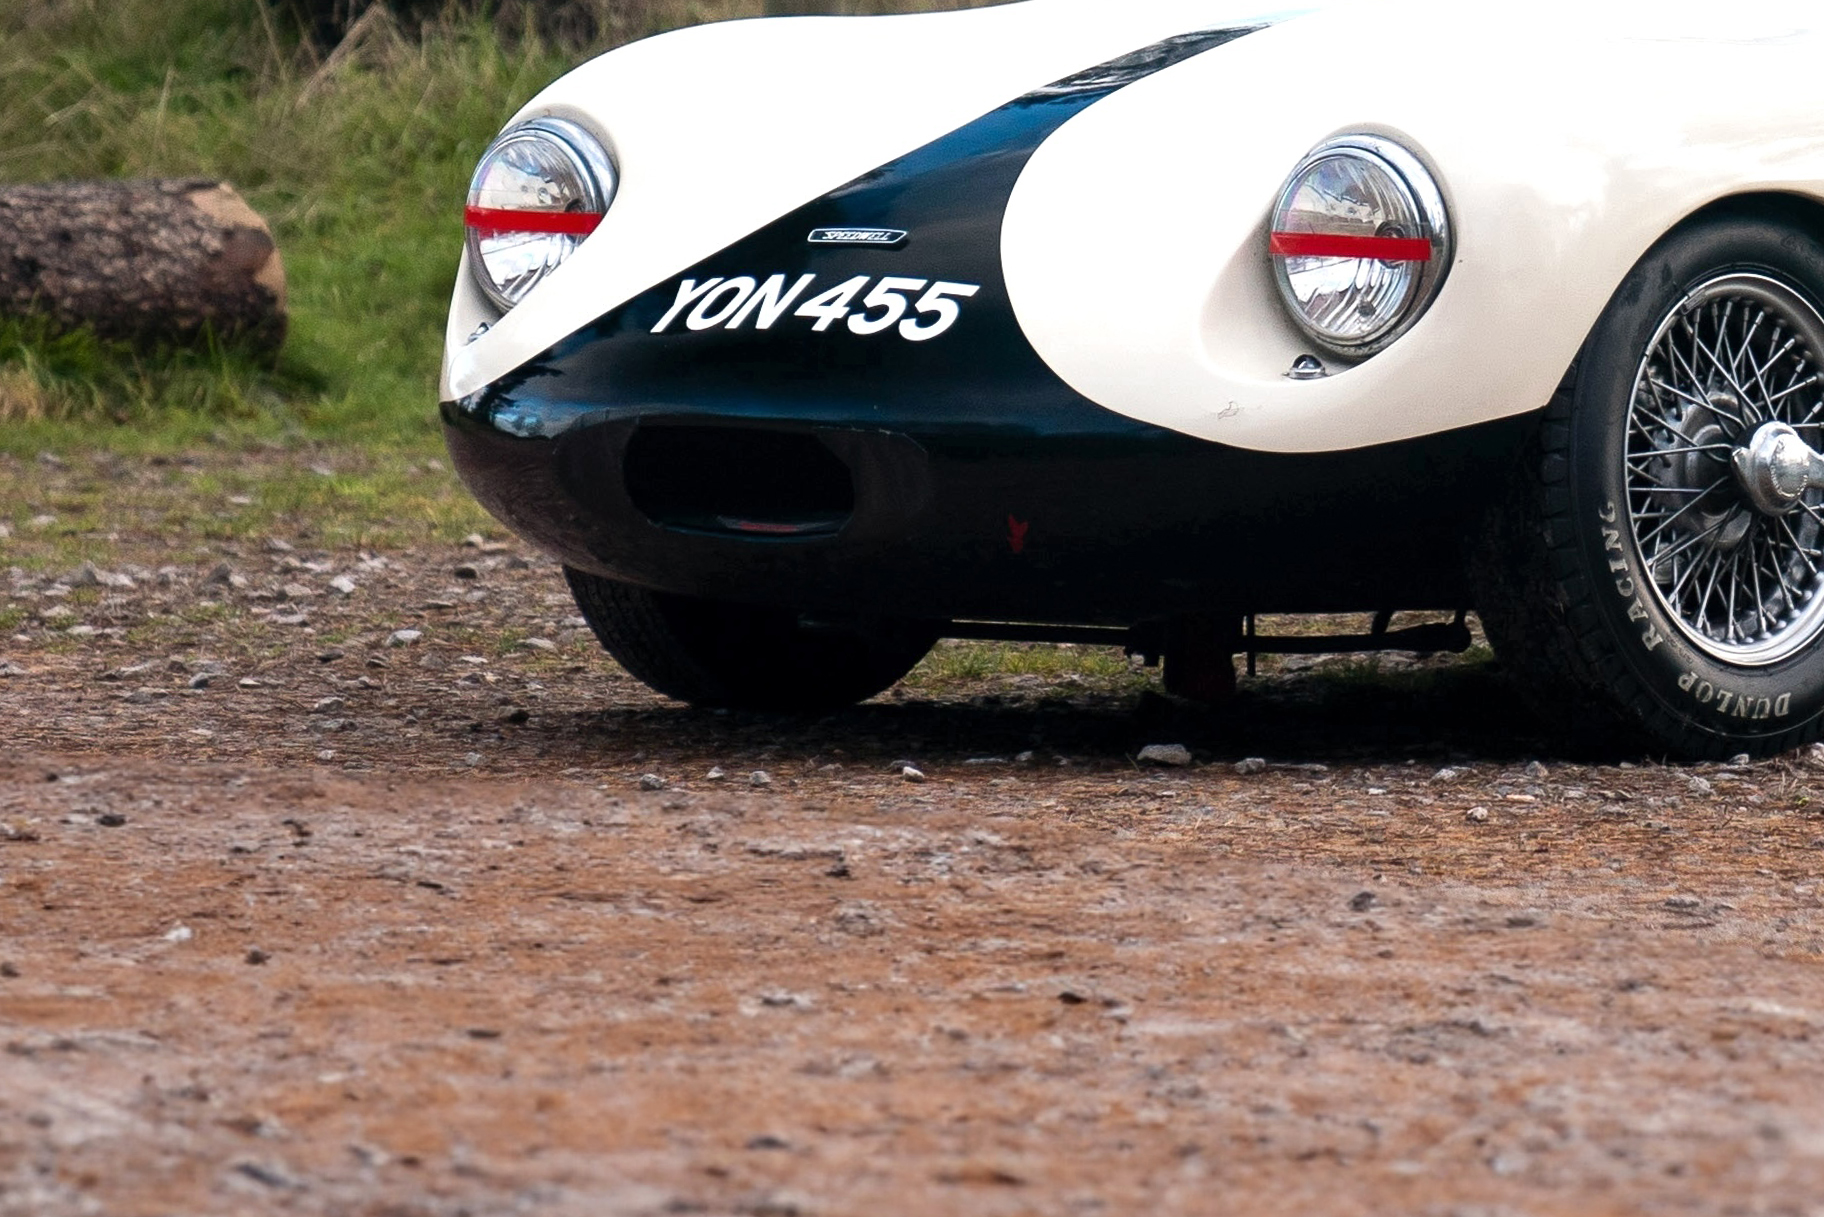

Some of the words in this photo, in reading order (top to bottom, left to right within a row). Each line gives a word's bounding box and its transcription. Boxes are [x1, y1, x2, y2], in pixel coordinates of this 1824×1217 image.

[822, 231, 891, 241] SPEEDWELL
[650, 274, 816, 333] YON
[794, 275, 980, 341] 455
[1599, 501, 1664, 651] RACING
[1678, 671, 1792, 719] DUNLOP
